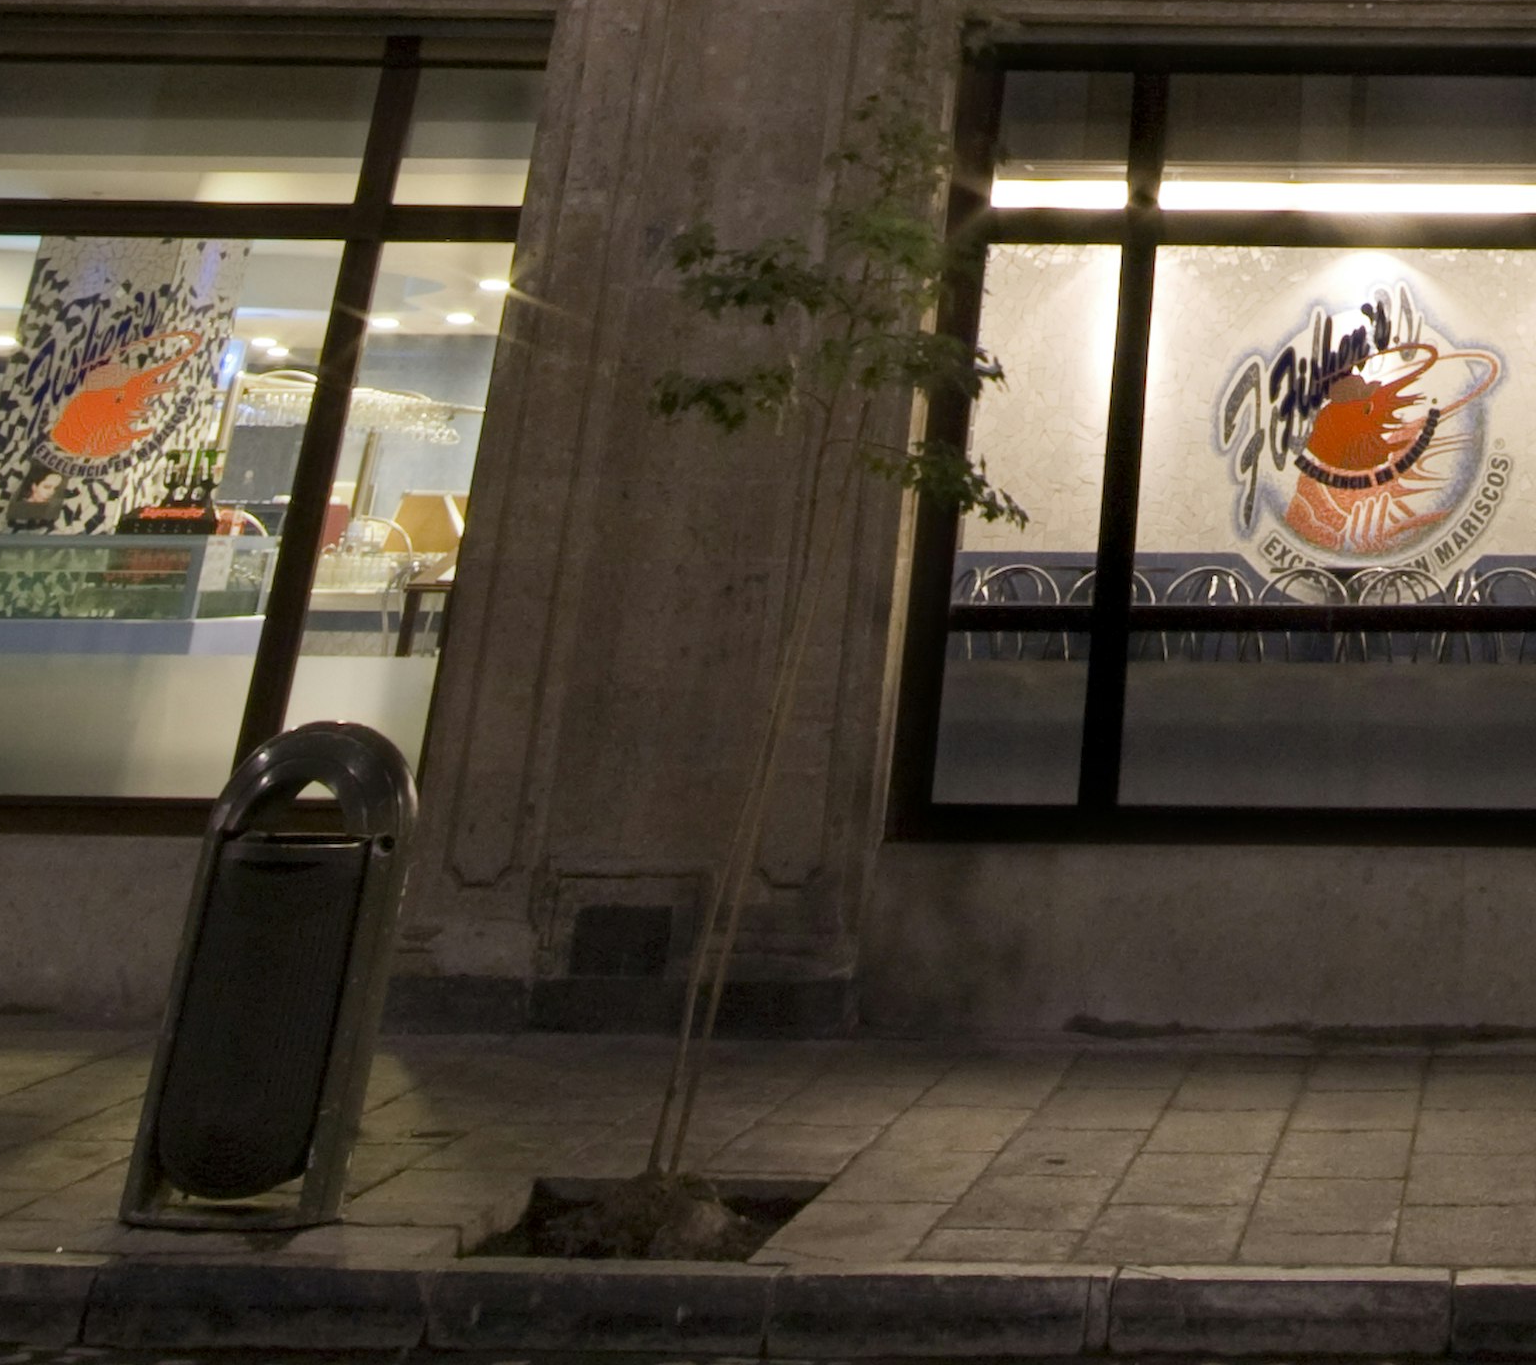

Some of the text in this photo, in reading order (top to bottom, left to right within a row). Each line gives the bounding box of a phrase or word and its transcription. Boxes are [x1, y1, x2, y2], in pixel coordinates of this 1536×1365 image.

[25, 291, 157, 439] Fisher's
[1269, 302, 1392, 455] Fisher's
[35, 444, 110, 476] EXCELENCIA
[114, 455, 133, 471] EN
[1433, 455, 1510, 566] MARISCOS
